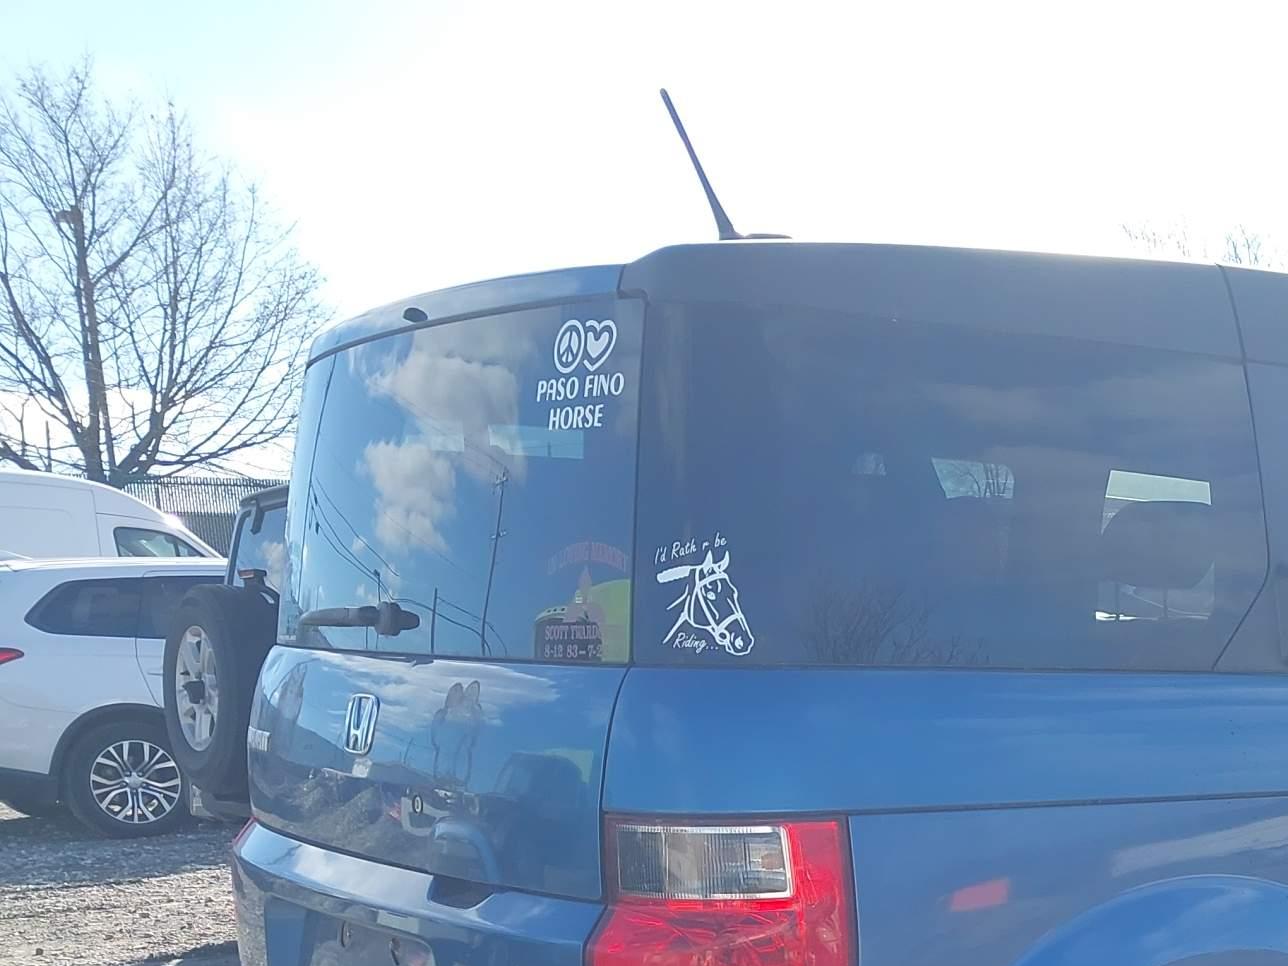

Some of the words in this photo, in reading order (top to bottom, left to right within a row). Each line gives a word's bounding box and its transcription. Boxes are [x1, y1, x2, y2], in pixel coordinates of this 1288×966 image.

[537, 376, 579, 403] PASO
[584, 372, 625, 398] FINO
[548, 404, 604, 431] HORSE
[654, 546, 667, 565] I'd
[714, 531, 727, 548] be
[544, 625, 569, 641] SCOTT
